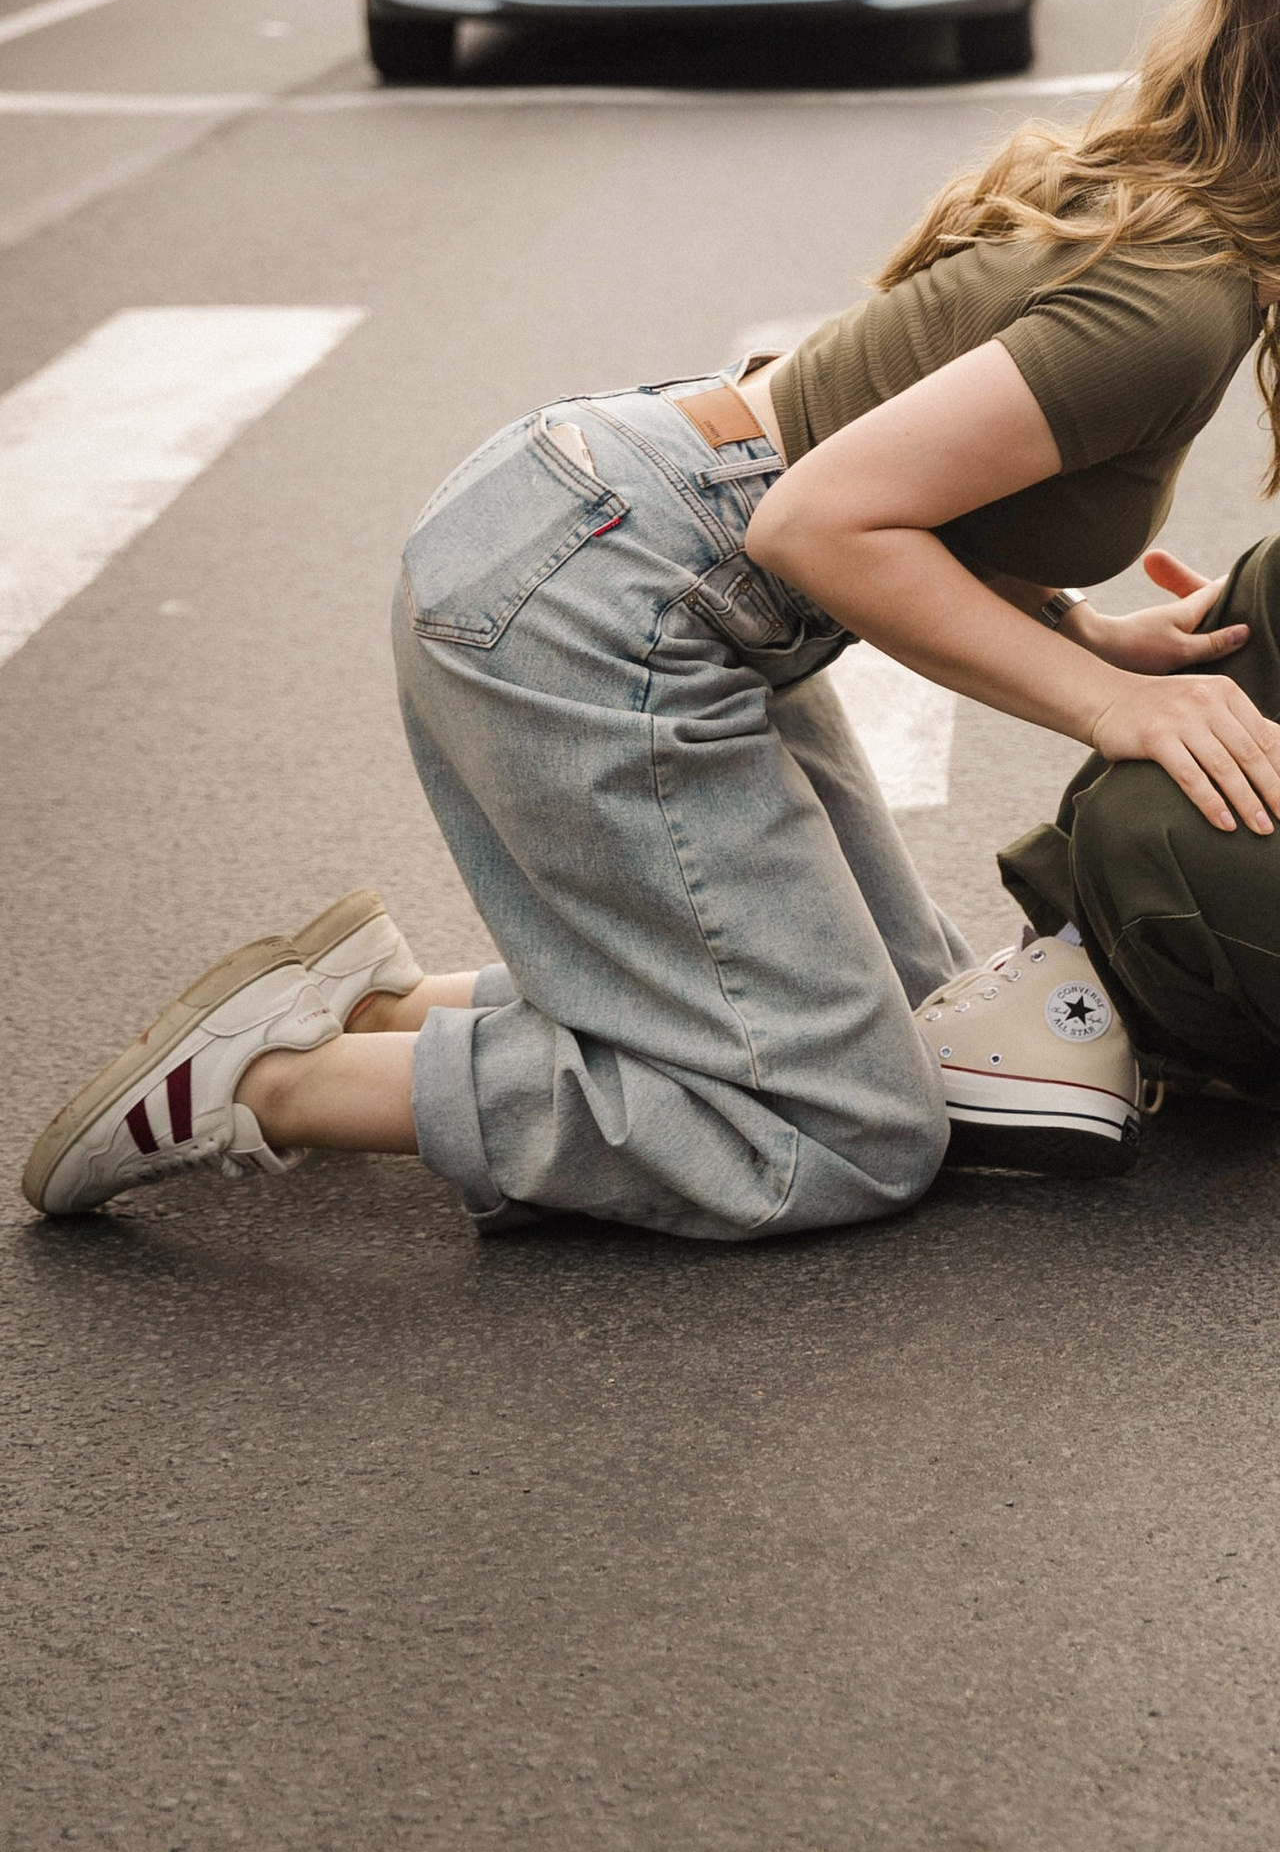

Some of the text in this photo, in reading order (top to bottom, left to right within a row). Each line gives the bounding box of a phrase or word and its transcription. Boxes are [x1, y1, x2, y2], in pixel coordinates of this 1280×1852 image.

[1057, 986, 1105, 1009] CONVERSE
[1053, 1018, 1095, 1036] ALL STAR
